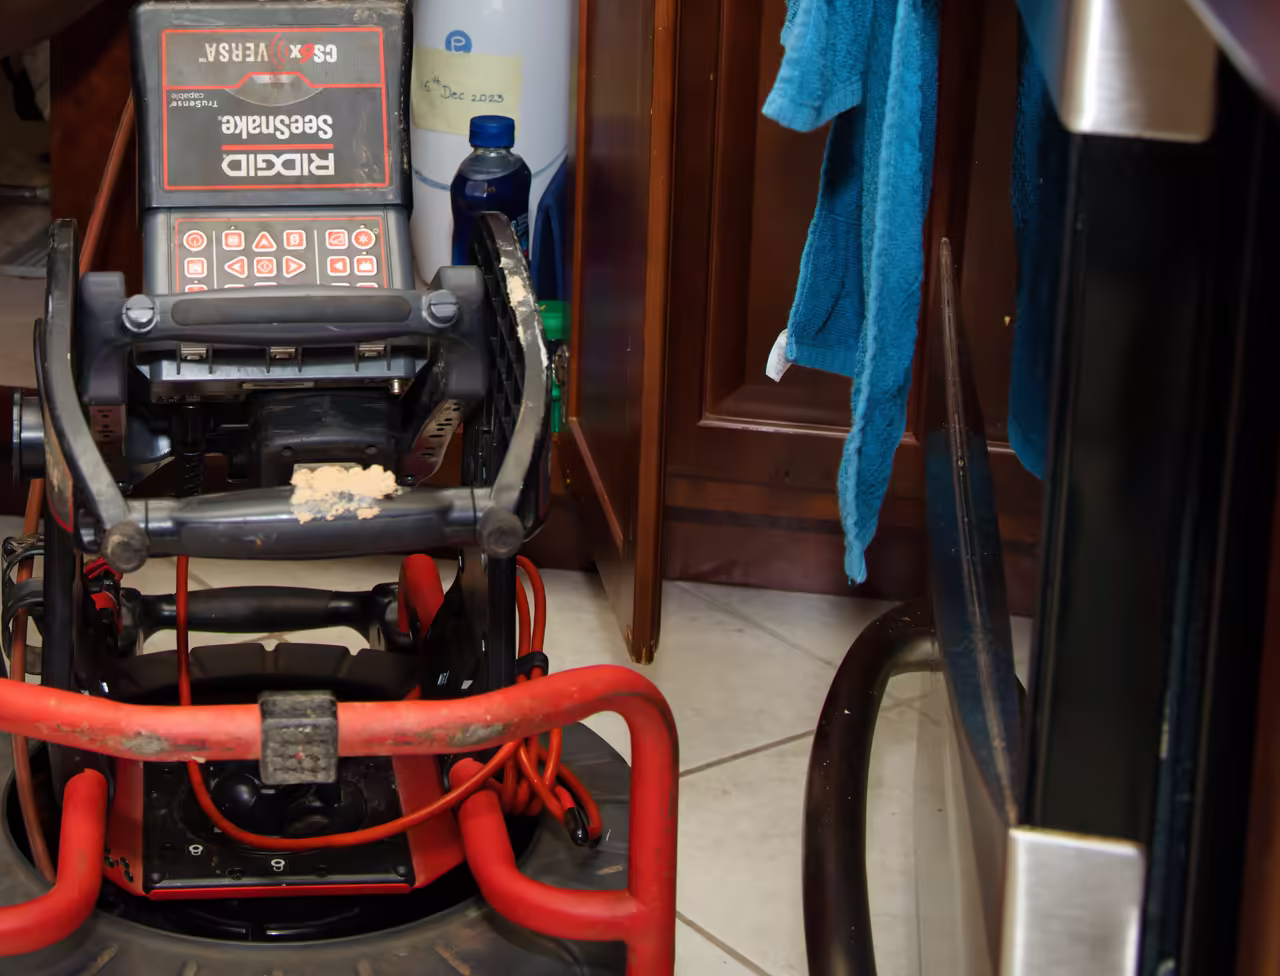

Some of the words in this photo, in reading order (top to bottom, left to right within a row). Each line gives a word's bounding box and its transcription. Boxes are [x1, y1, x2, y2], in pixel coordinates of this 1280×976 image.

[171, 91, 205, 100] capable
[440, 85, 464, 100] Dec
[470, 93, 504, 104] 2023
[221, 114, 334, 140] SeeSnake
[221, 152, 335, 177] RIDGID
